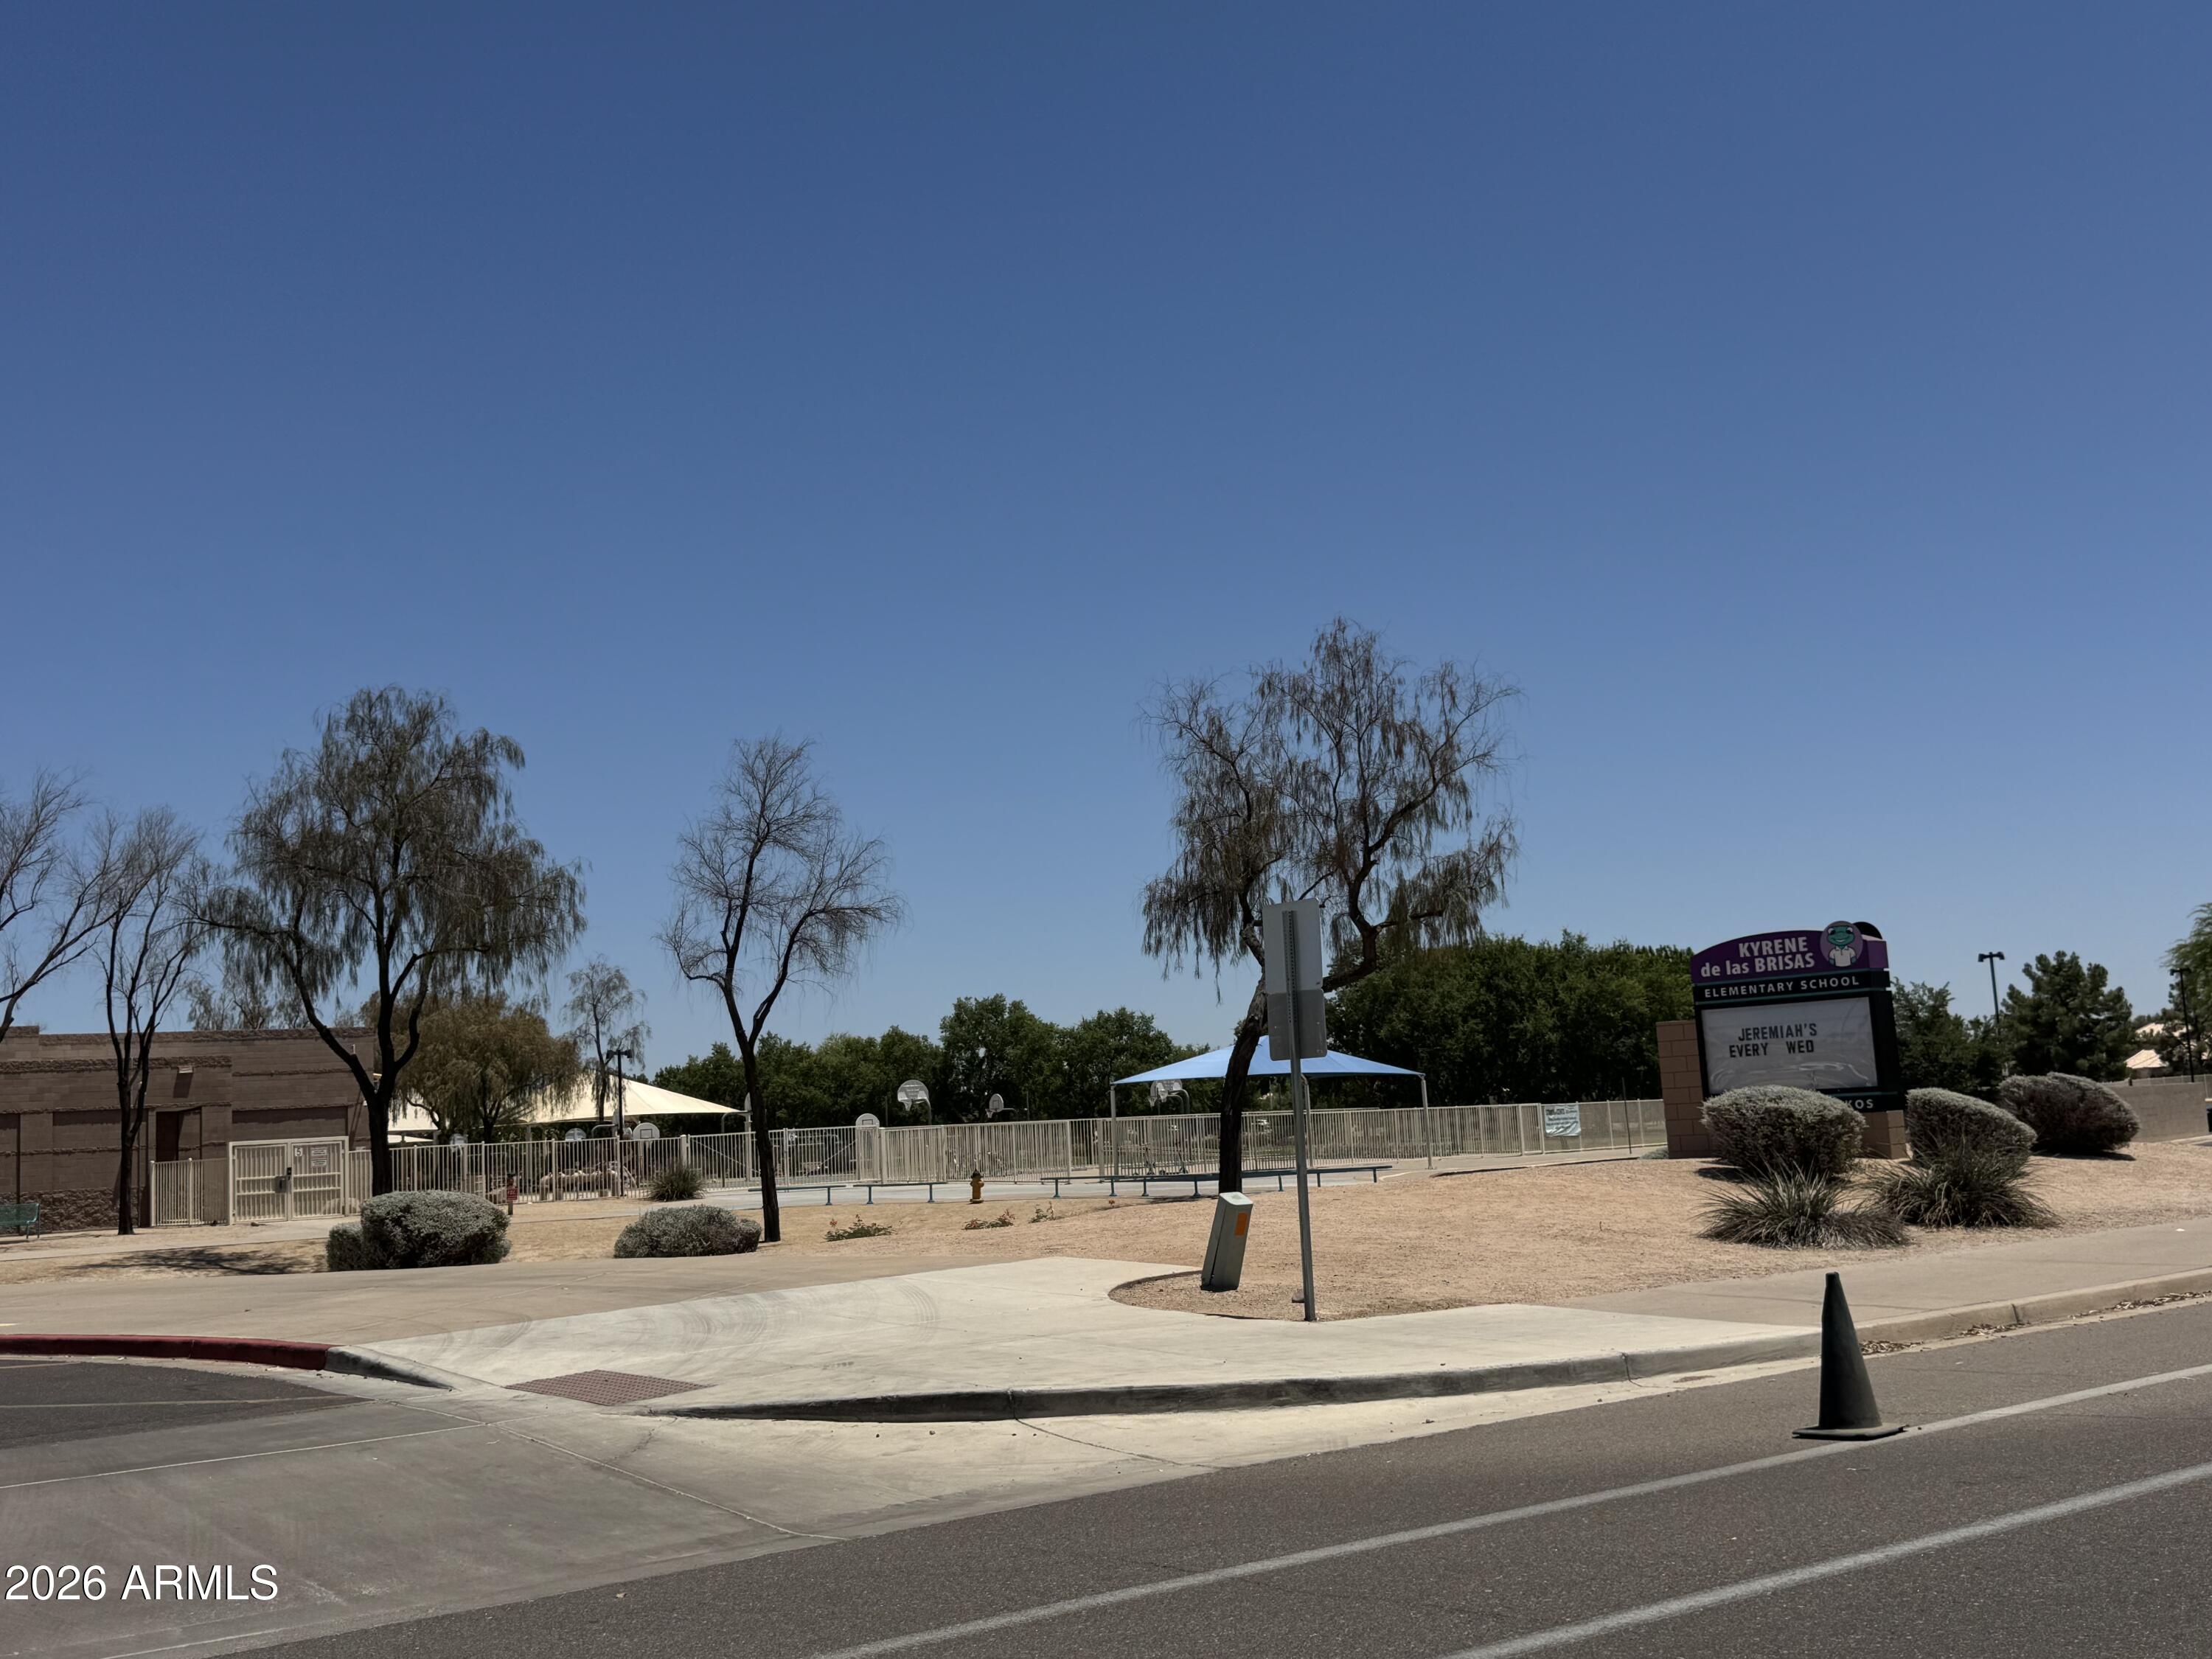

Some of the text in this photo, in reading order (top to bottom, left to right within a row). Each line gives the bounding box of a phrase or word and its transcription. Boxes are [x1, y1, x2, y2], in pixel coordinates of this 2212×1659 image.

[1739, 936, 1808, 958] KYRENE
[1700, 953, 1815, 978] de las BRISAS
[1704, 975, 1860, 998] ELEMENTARY SCHOOL
[1738, 1023, 1818, 1041] JEREMIAH'S
[1729, 1040, 1815, 1058] EVERY WED
